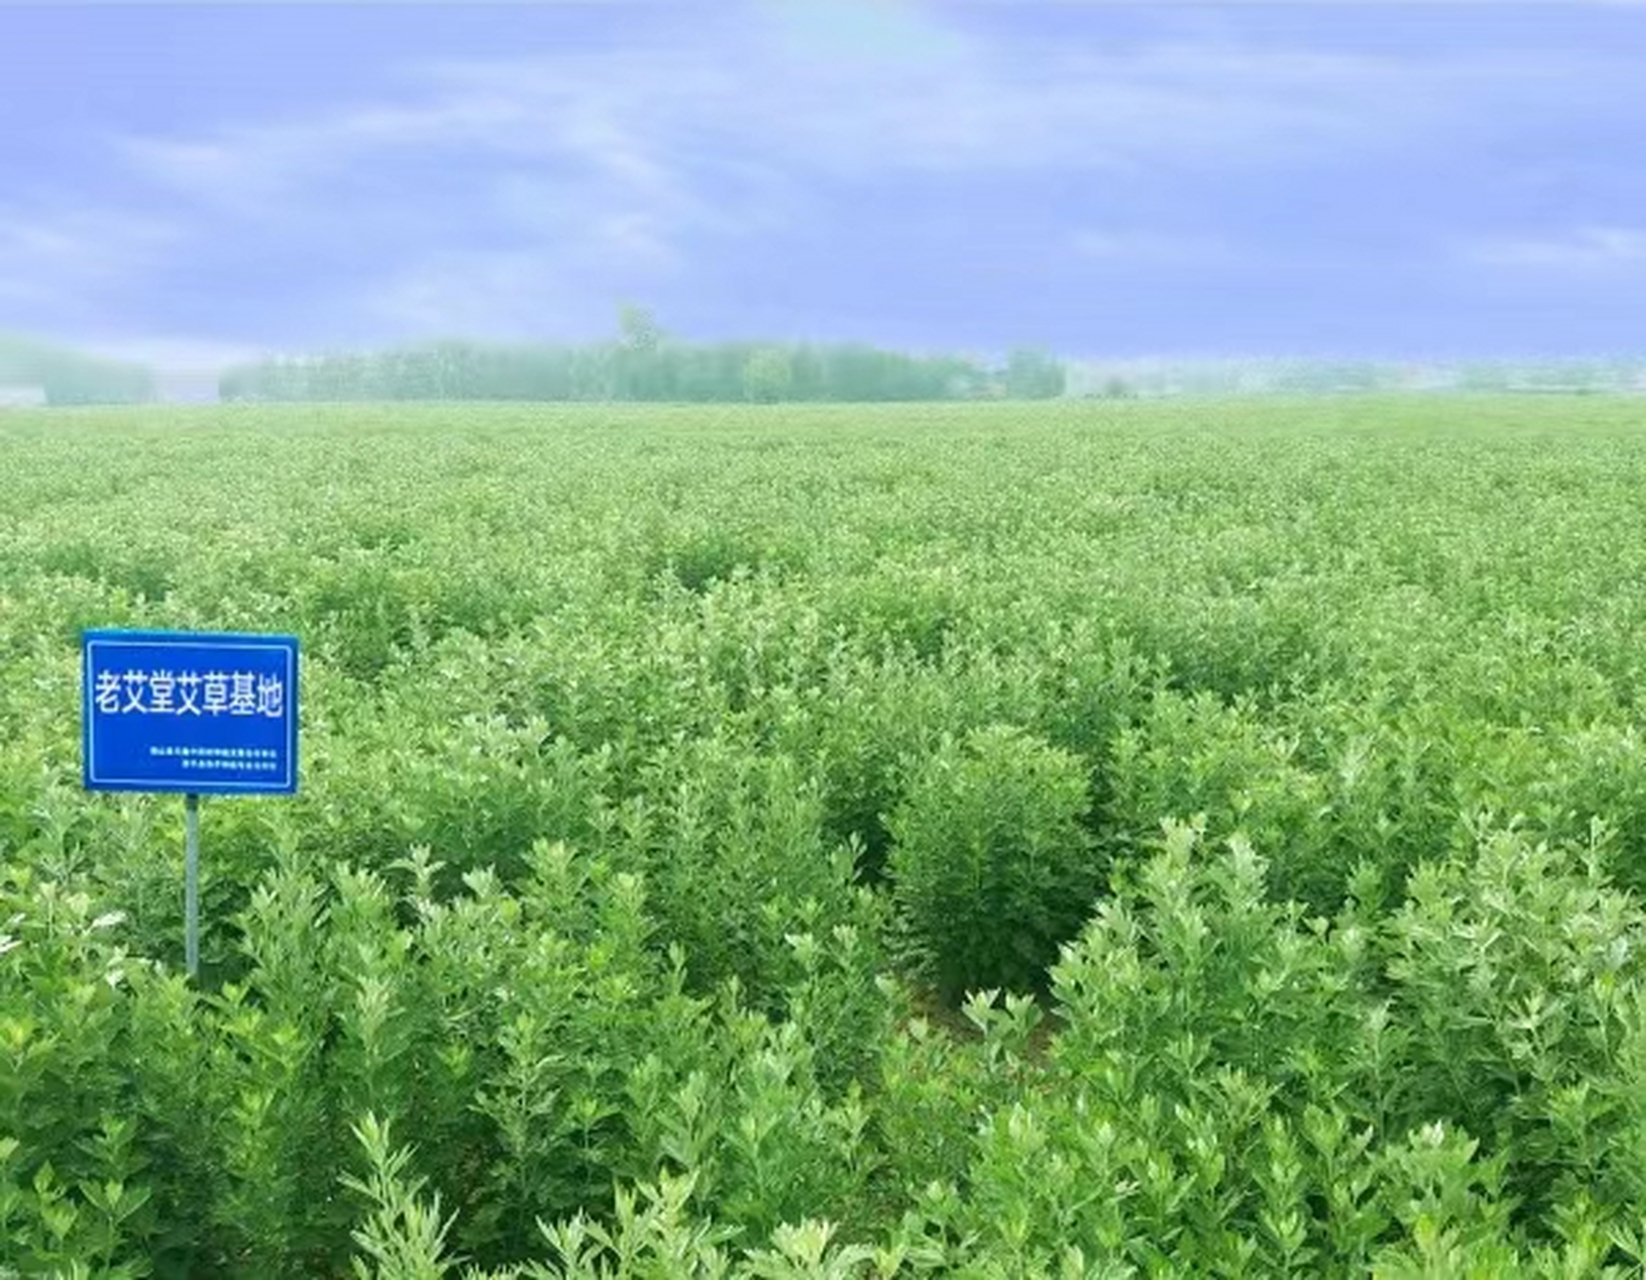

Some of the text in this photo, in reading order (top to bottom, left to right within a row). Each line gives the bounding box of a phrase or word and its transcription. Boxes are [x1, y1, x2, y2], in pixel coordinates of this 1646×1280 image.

[95, 669, 284, 718] 老艾堂艾草基地
